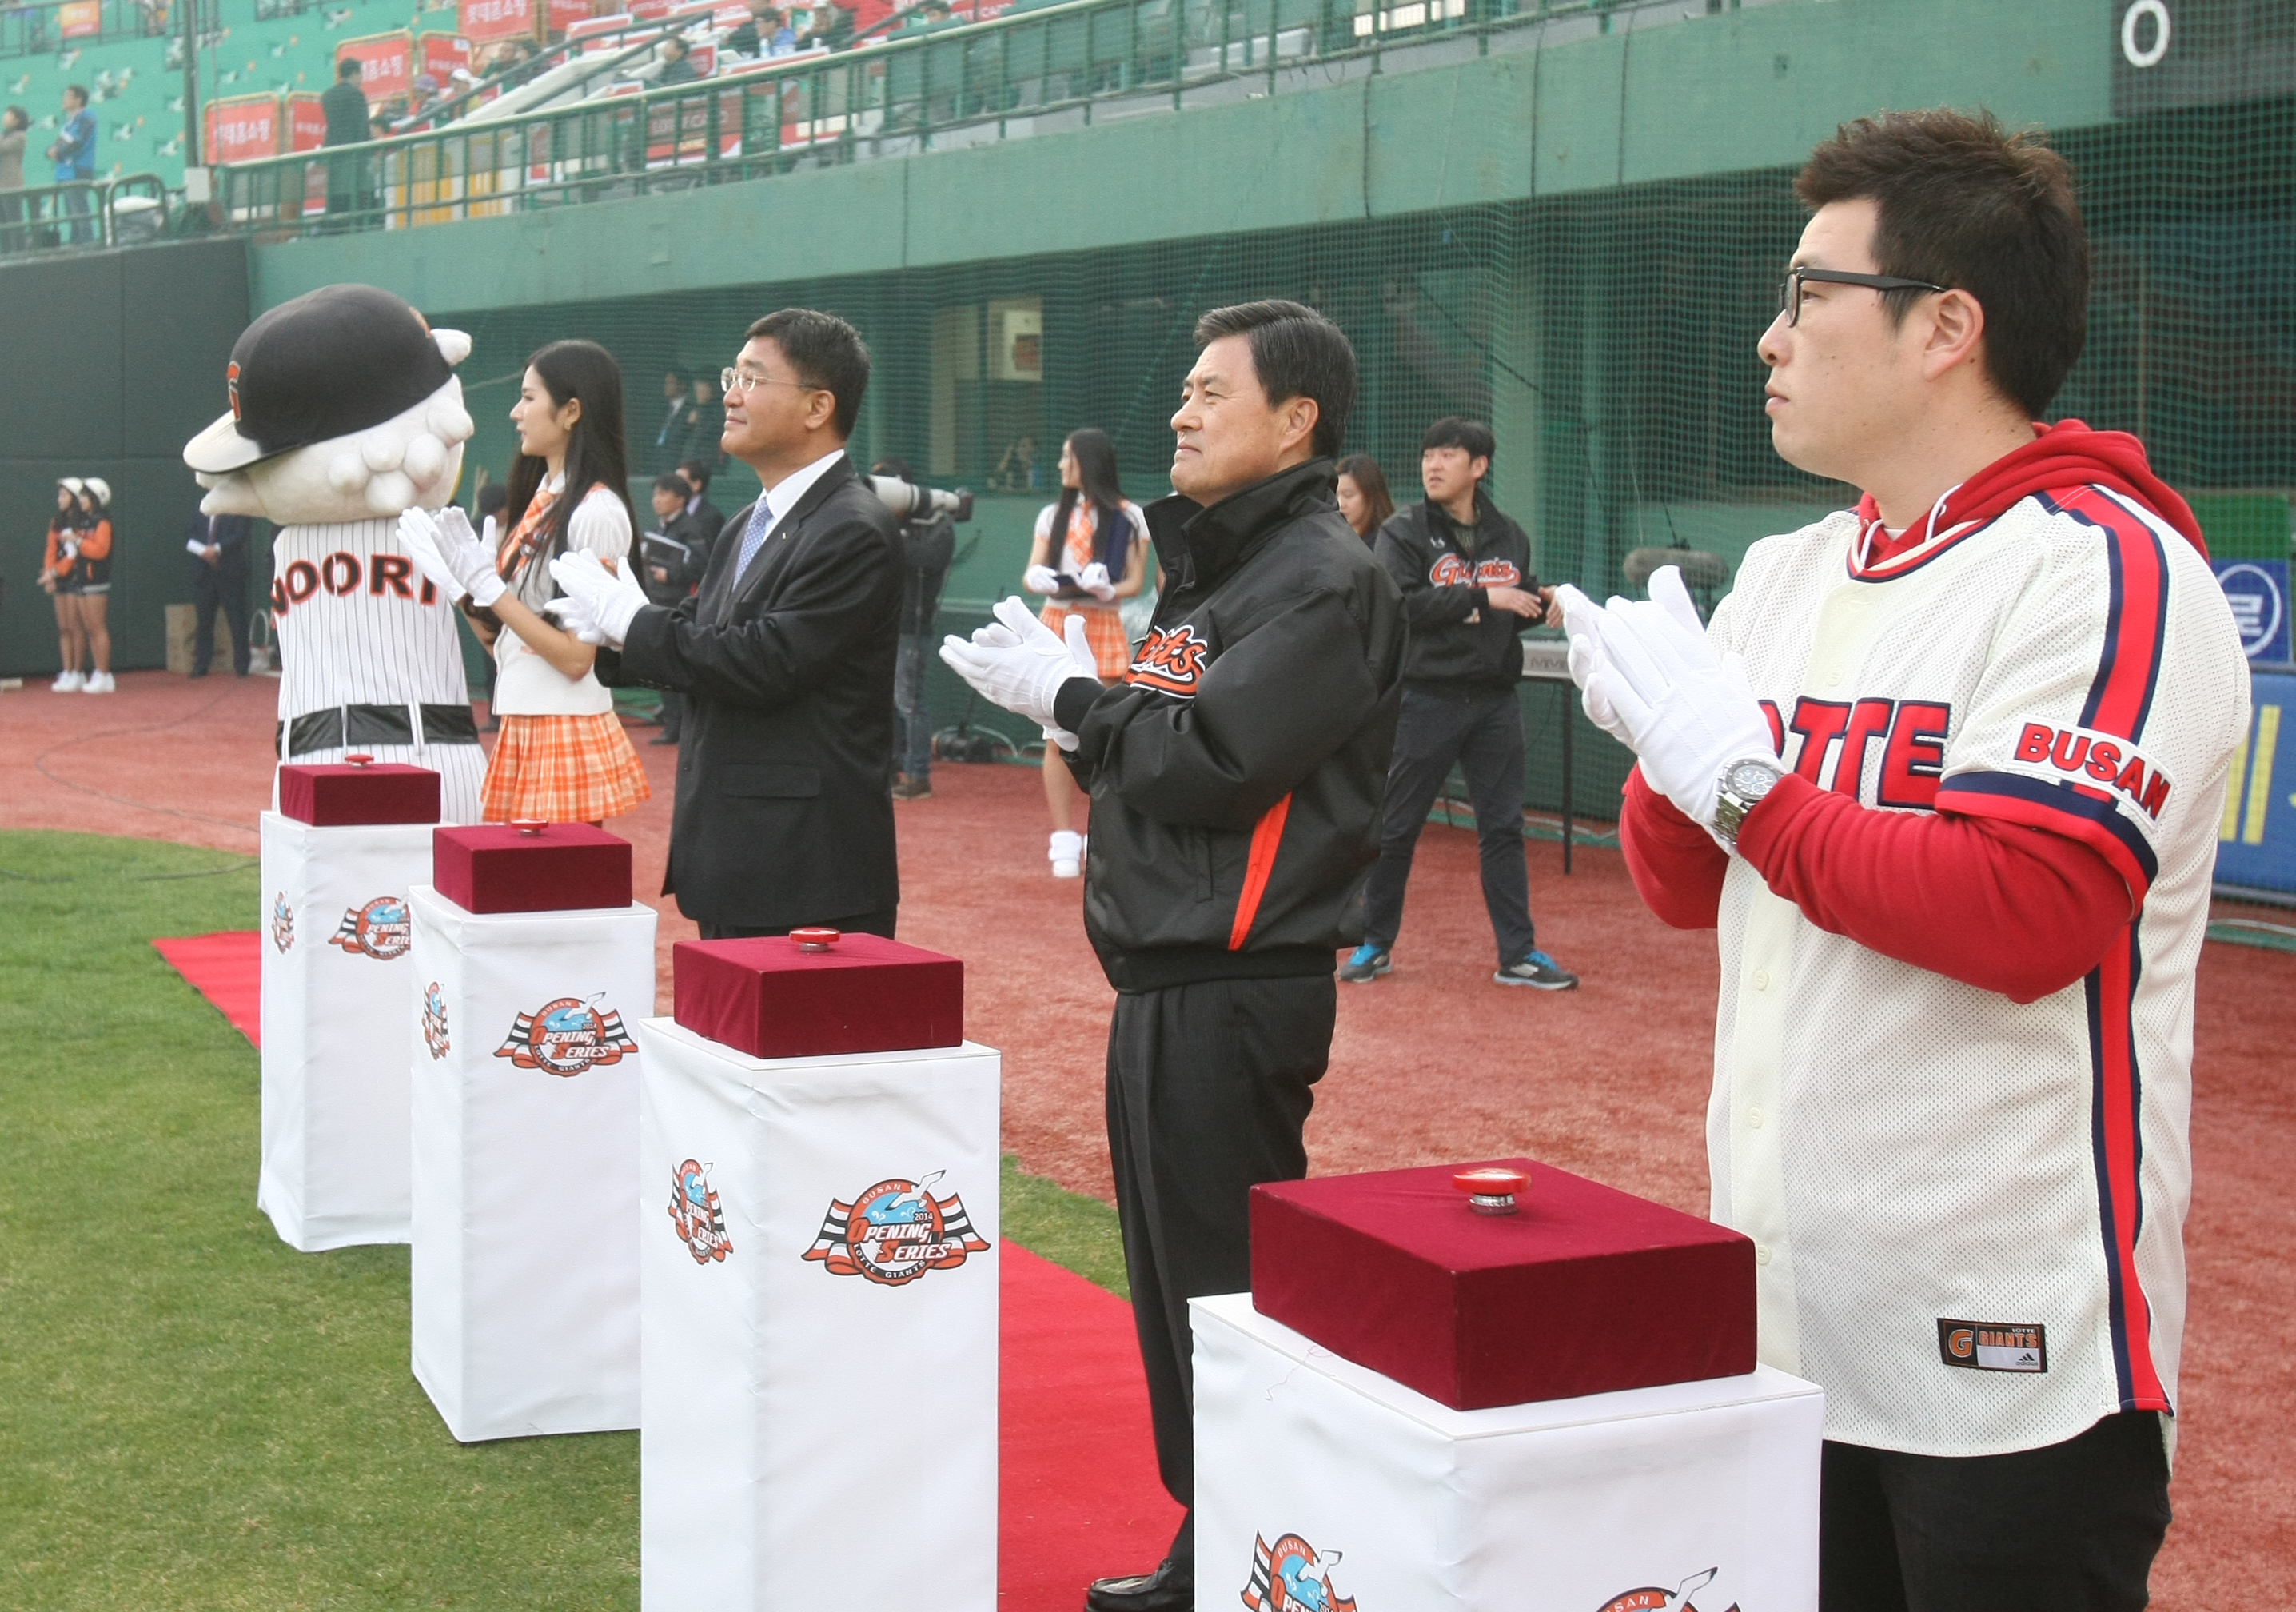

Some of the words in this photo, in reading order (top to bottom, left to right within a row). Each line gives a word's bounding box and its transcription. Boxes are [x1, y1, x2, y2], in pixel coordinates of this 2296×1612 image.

[1758, 695, 1951, 810] TTE
[2014, 722, 2171, 821] BUSAN
[528, 1026, 597, 1047] OPENING
[551, 1043, 611, 1059] SERIES
[862, 1183, 902, 1205] BUSAN
[913, 1212, 934, 1222] 2014
[847, 1216, 933, 1243] OPENING
[852, 1243, 879, 1274] LOTTE
[884, 1259, 927, 1279] GIANTS
[875, 1239, 952, 1263] SERIES
[1948, 1328, 1974, 1359] G
[1978, 1331, 2039, 1348] GIANTS
[1278, 1540, 1305, 1558] BUSAN
[1605, 1595, 1649, 1612] SAN
